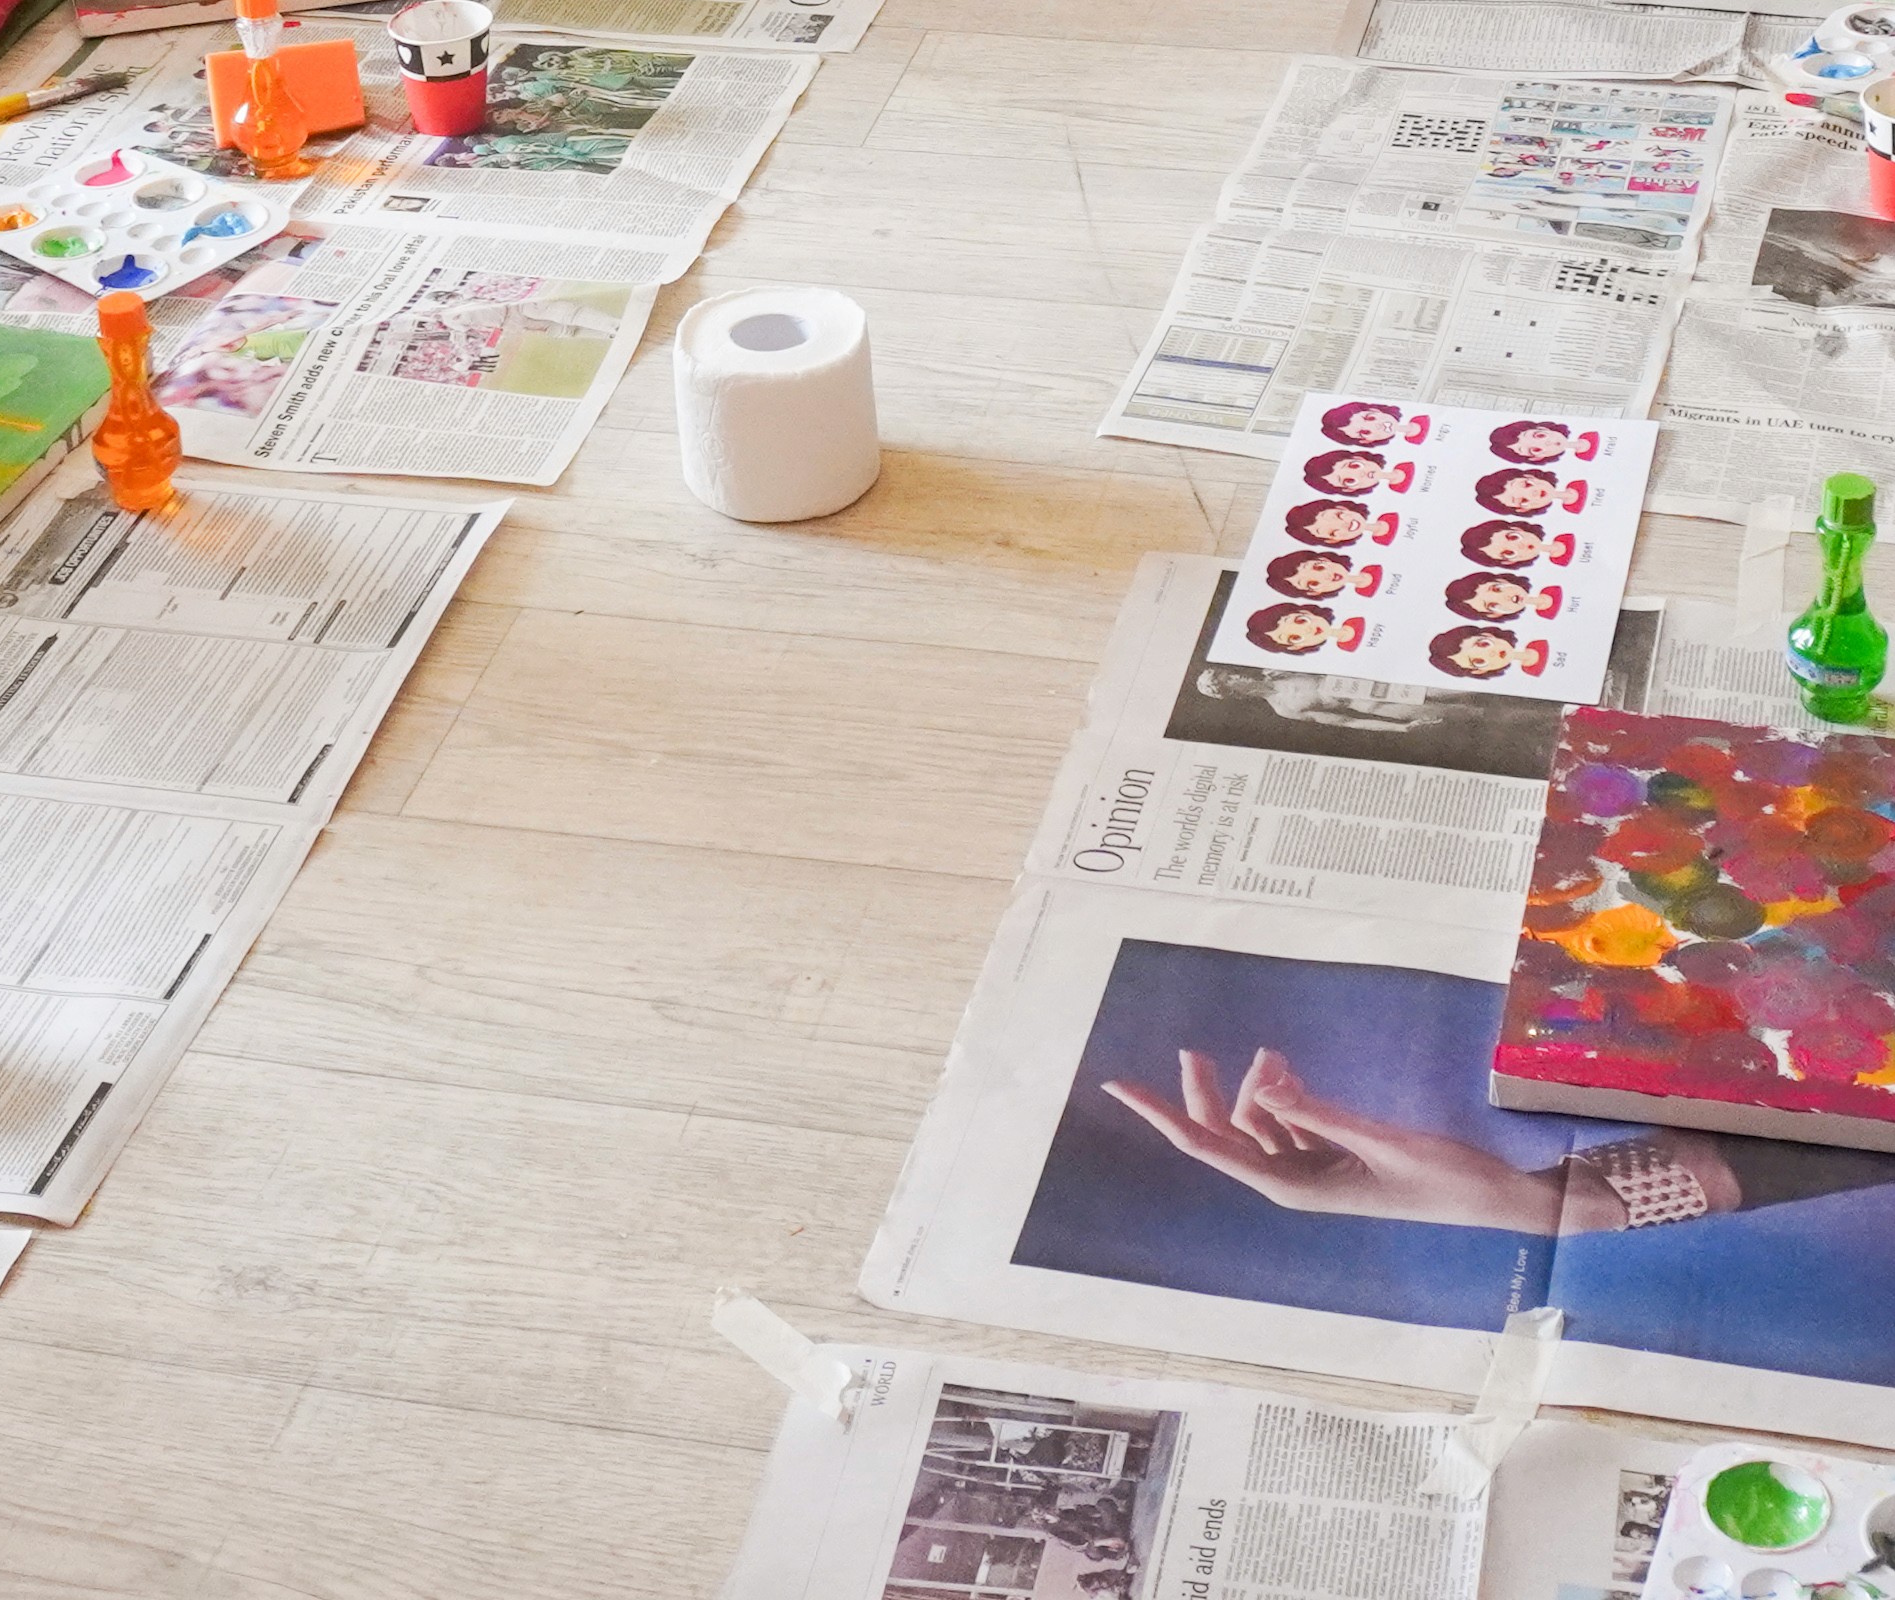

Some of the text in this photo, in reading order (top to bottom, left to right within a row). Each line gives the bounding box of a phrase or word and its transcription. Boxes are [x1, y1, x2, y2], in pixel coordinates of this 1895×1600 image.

[1795, 131, 1858, 152] speeds
[333, 129, 419, 215] Pakistan performan
[1634, 176, 1698, 188] Archie
[1217, 322, 1293, 338] HOROSCOPE
[1790, 316, 1828, 332] Need
[1831, 322, 1854, 334] for
[255, 234, 427, 458] Steven Smith adds new to his Oval love affair
[1434, 423, 1452, 442] Angry
[1667, 407, 1741, 427] Migrants
[1744, 415, 1761, 426] in
[1766, 416, 1805, 429] UAE
[1809, 423, 1846, 435] turn
[1849, 426, 1867, 439] to
[1604, 435, 1618, 457] Afraid
[1420, 465, 1438, 494] Worried
[1592, 487, 1605, 507] Tired
[1404, 517, 1420, 540] Joyful
[1579, 541, 1594, 564] Upset
[52, 566, 75, 581] JOB
[1384, 573, 1402, 596] Proud
[1567, 596, 1581, 613] Hurt
[1366, 623, 1385, 649] Happy
[1553, 652, 1567, 669] Sad
[1223, 773, 1249, 796] risk
[1223, 797, 1241, 814] at
[1072, 768, 1155, 873] Opinion
[1153, 764, 1218, 882] The world's digital
[1197, 828, 1234, 887] memory
[1507, 1247, 1529, 1312] Bee My Love
[871, 1360, 897, 1409] WORLD
[1188, 1498, 1227, 1576] aid ends
